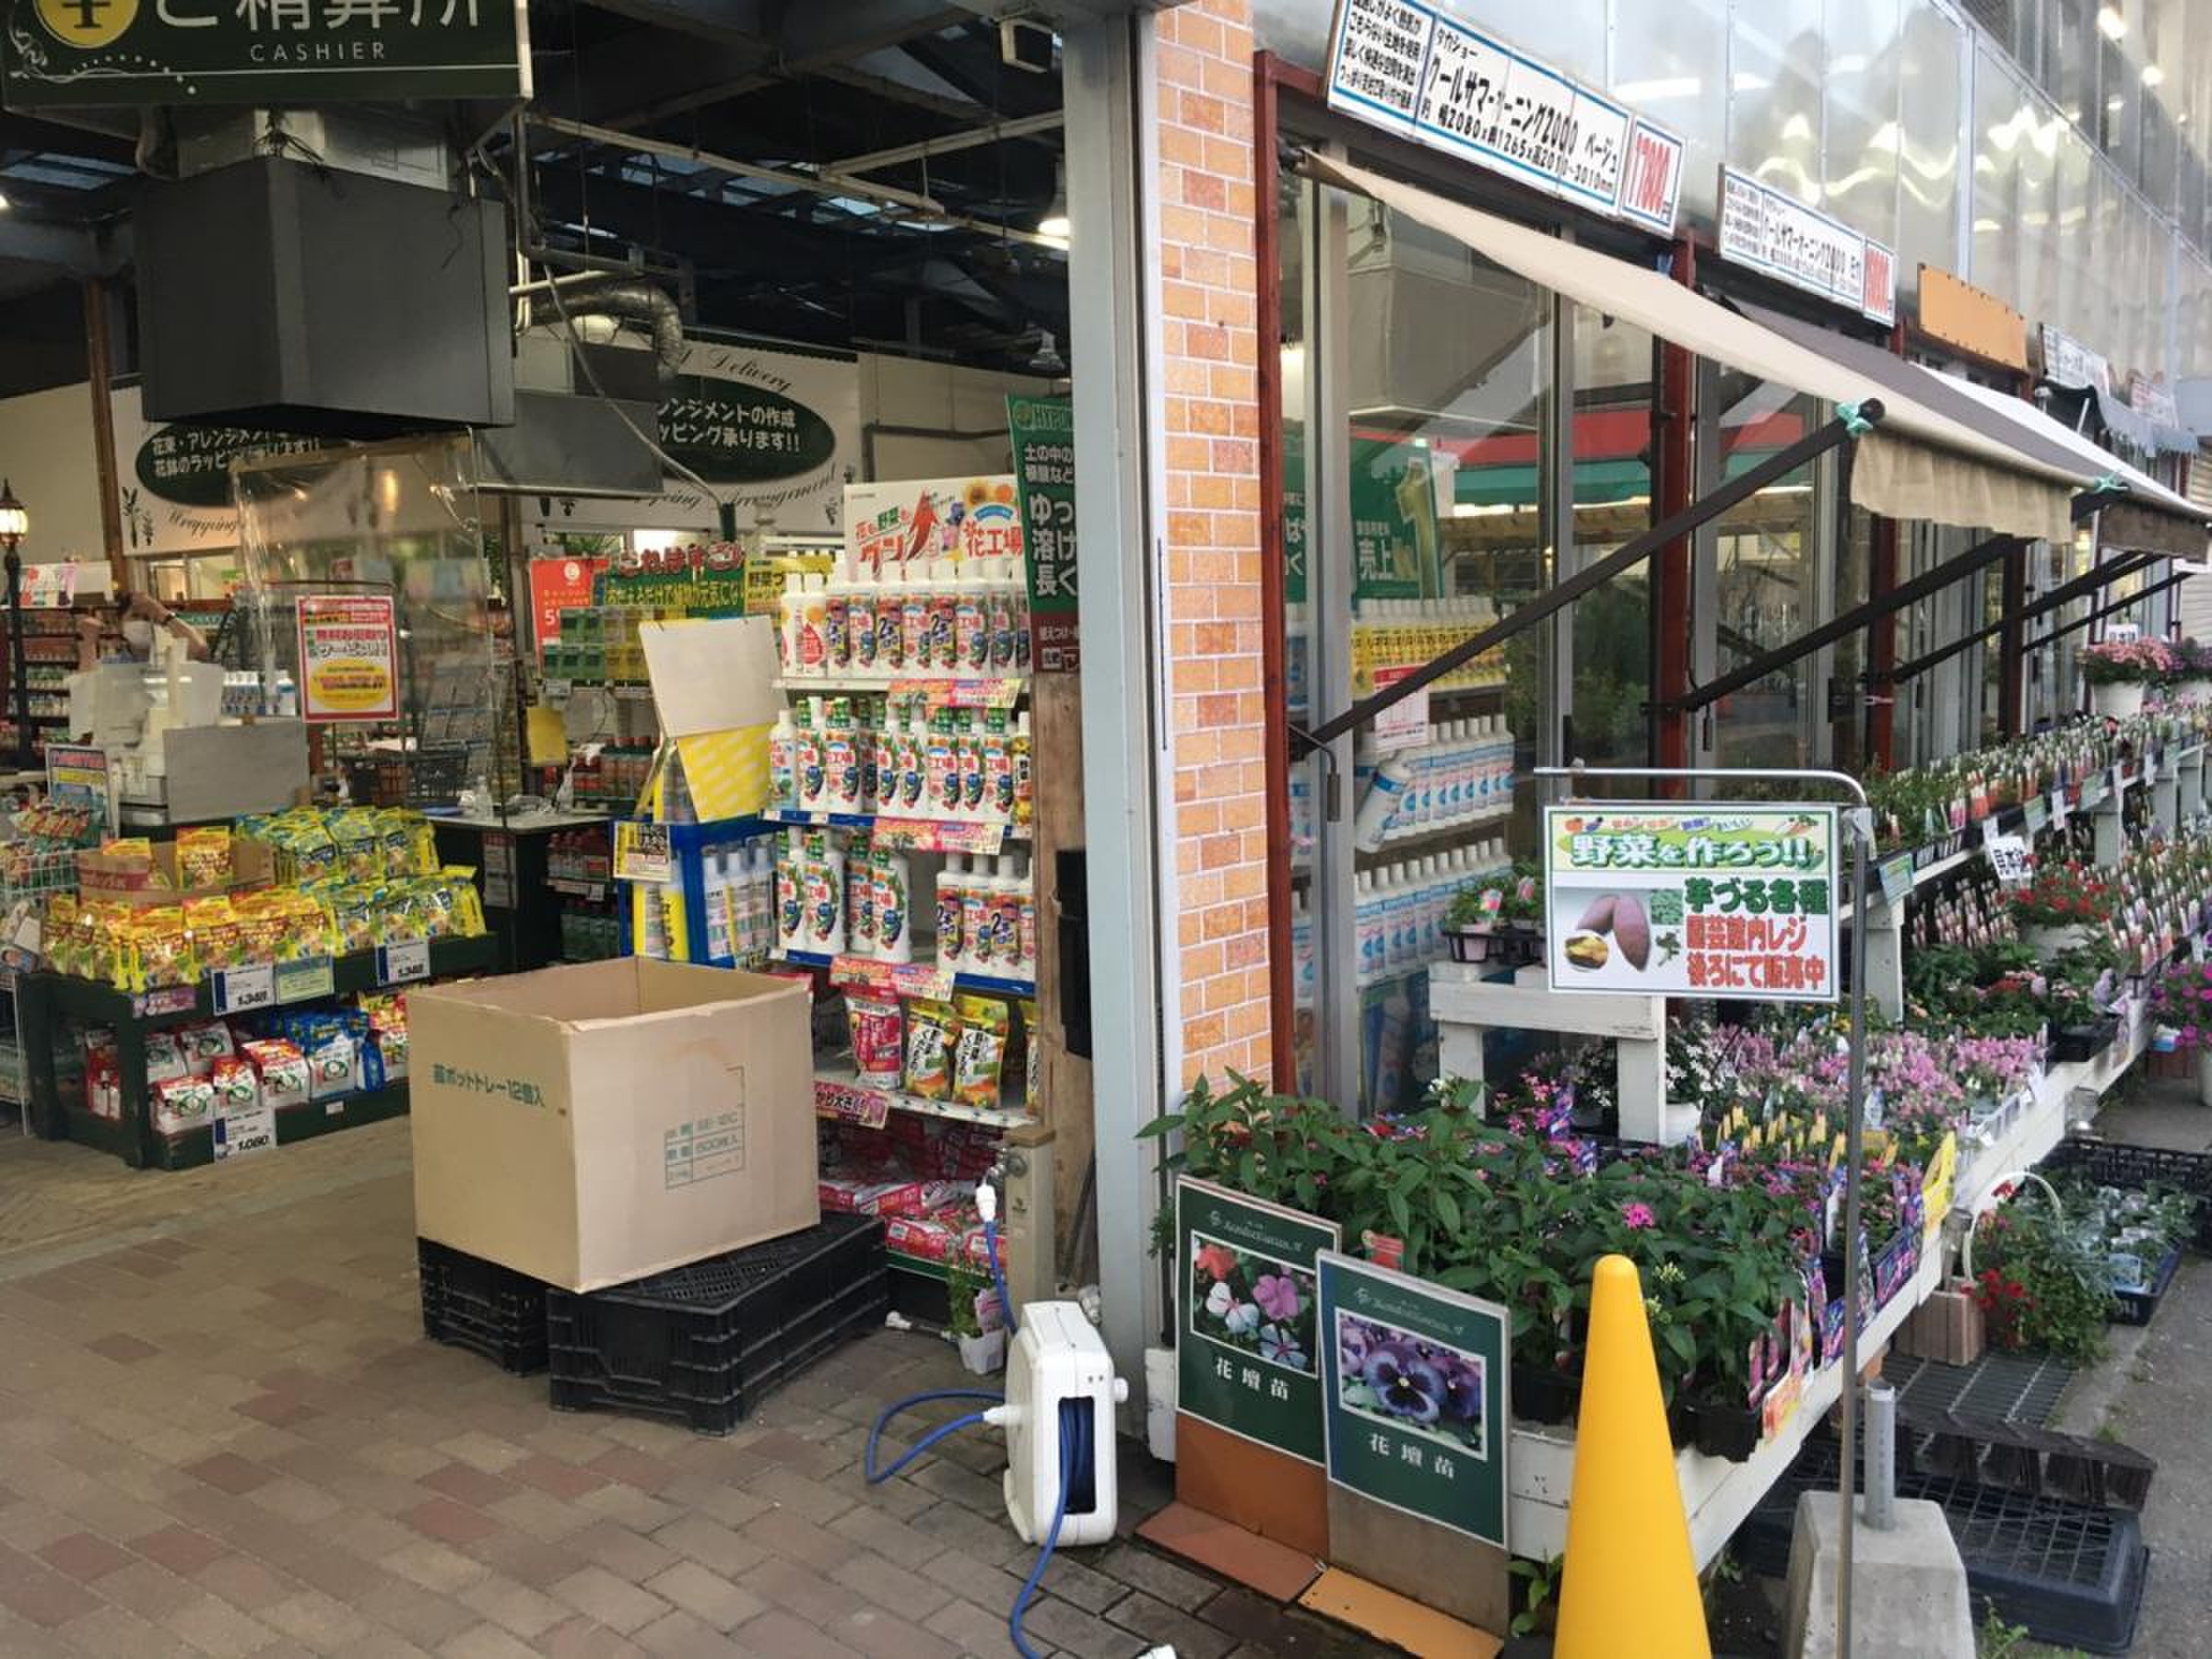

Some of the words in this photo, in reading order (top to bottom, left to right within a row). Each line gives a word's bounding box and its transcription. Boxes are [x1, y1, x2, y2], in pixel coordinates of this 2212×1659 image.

[251, 41, 385, 61] CASHIER
[963, 521, 1023, 558] 花工場
[1683, 877, 1830, 914] 芋づる各種
[1687, 952, 1826, 990] 後ろにて販売中
